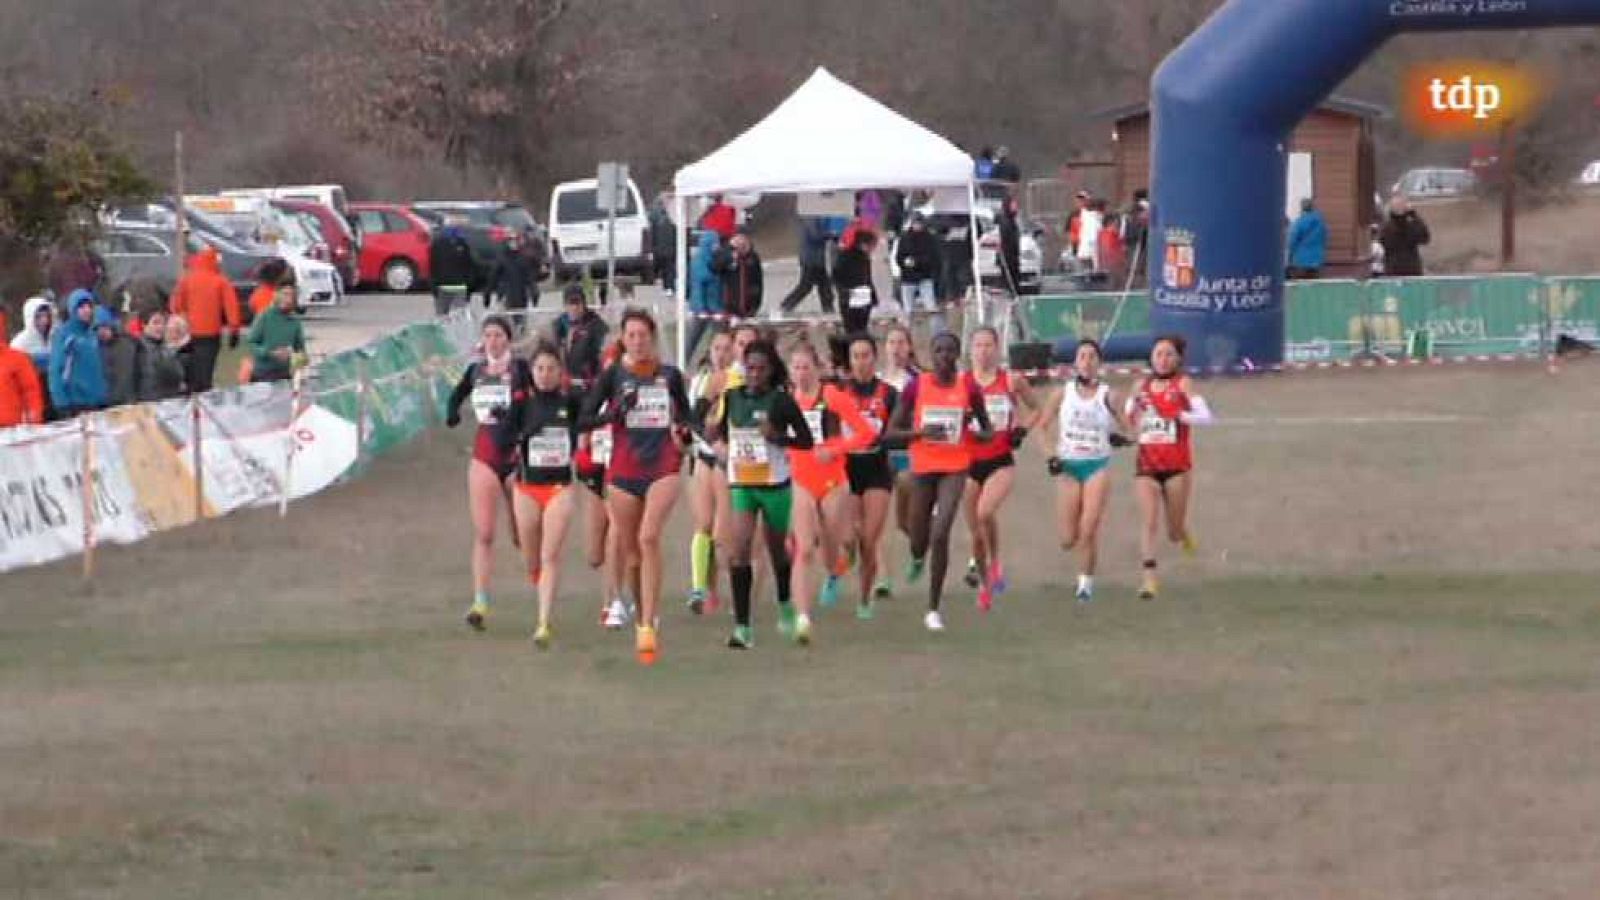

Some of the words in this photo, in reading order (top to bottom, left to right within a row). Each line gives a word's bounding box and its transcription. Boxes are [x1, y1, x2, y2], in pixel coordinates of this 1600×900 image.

[1389, 0, 1457, 16] Castilla
[1461, 3, 1474, 16] y
[1197, 276, 1247, 294] Junta
[1251, 275, 1271, 291] de
[1155, 287, 1209, 308] Castilla
[1214, 294, 1228, 312] y
[1231, 290, 1271, 308] León
